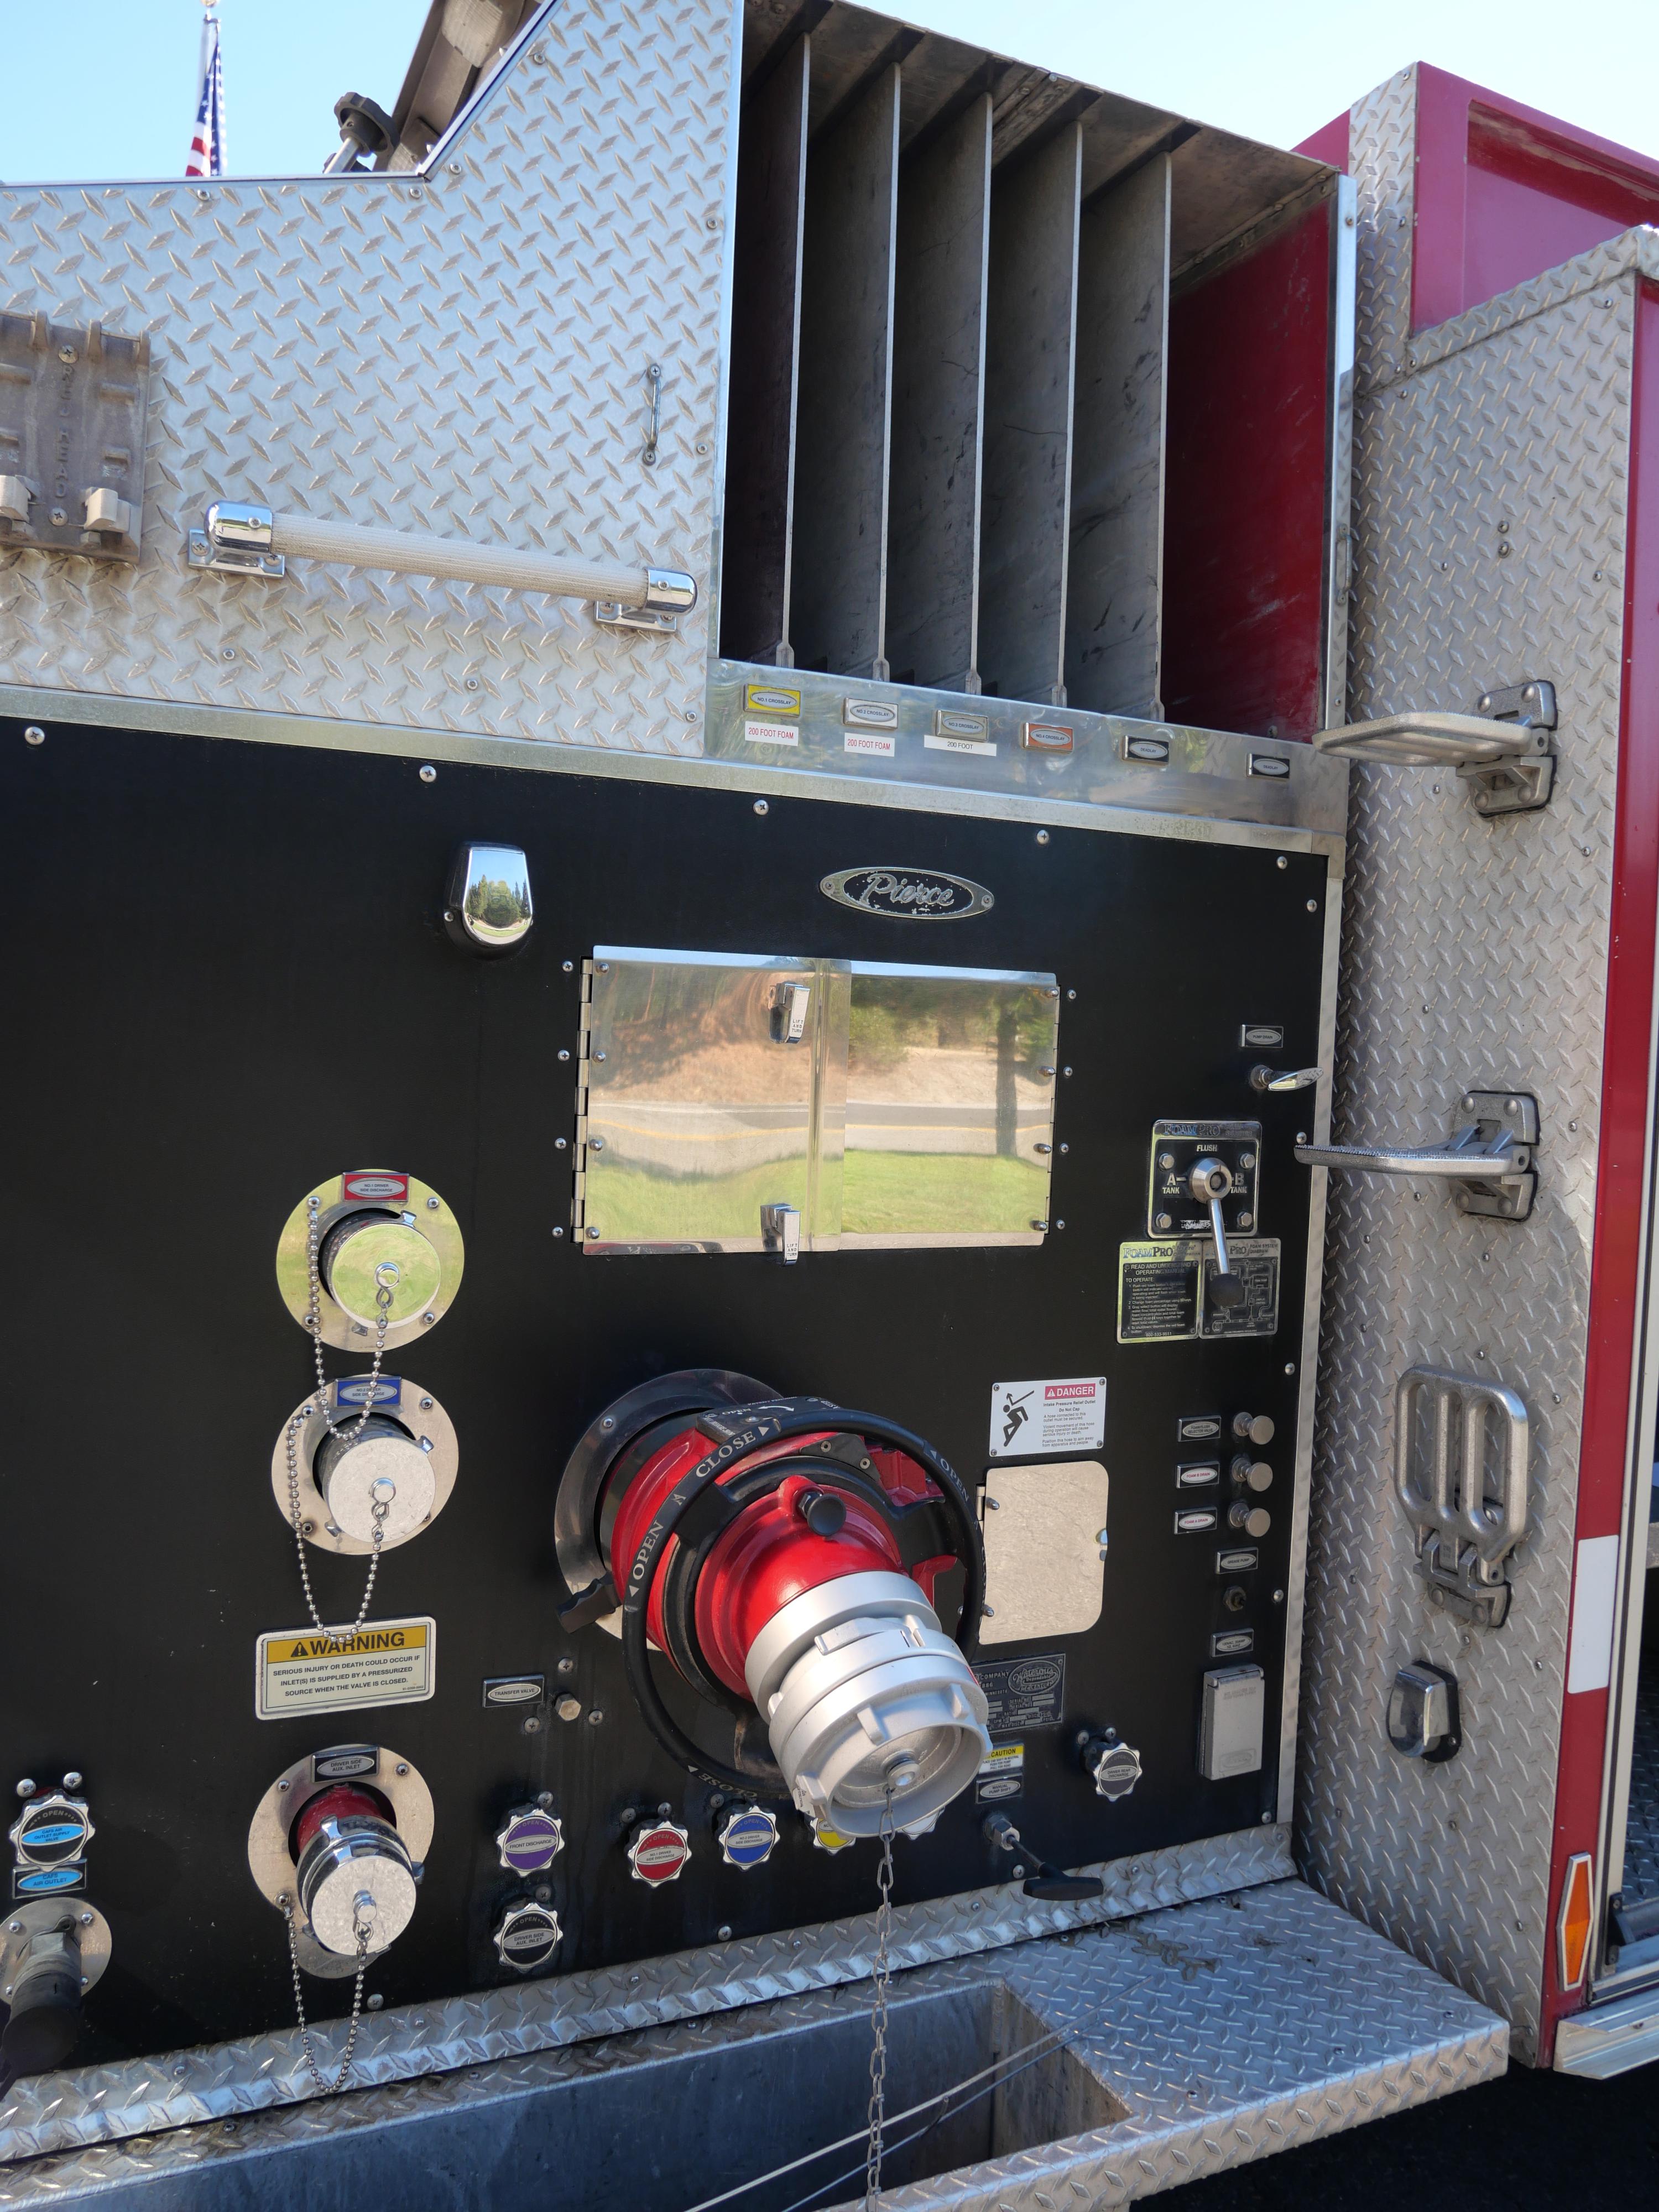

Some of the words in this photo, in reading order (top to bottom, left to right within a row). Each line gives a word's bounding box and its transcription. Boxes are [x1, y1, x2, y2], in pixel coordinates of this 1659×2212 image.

[748, 727, 759, 735] 200
[760, 729, 776, 738] FOOT
[778, 731, 794, 739] FOAM
[858, 740, 874, 749] FOOT
[875, 742, 891, 750] FOAM
[859, 873, 954, 906] Pierce
[1167, 1172, 1176, 1186] A
[1235, 1172, 1244, 1185] B
[1057, 1386, 1094, 1397] DANGER
[696, 1431, 755, 1478] CLOSE
[941, 1458, 969, 1502] OPEN
[633, 1520, 664, 1580] OPEN
[310, 1632, 405, 1655] WARNING
[273, 1668, 303, 1676] SERIOUS
[280, 1678, 309, 1687] INLET(S)
[317, 1673, 350, 1682] SUPPLIED
[368, 1667, 413, 1676] PRESSURIZED
[980, 1671, 1010, 1680] COMPANY
[1012, 1667, 1054, 1684] Waterous
[285, 1688, 314, 1697] SOURCE
[350, 1682, 372, 1690] VALVE
[380, 1678, 409, 1686] CLOSED.
[991, 1748, 1016, 1757] CAUTION
[43, 1809, 65, 1818] OPEN
[526, 1839, 552, 1847] DISCHARGE
[520, 1916, 538, 1924] OPEN
